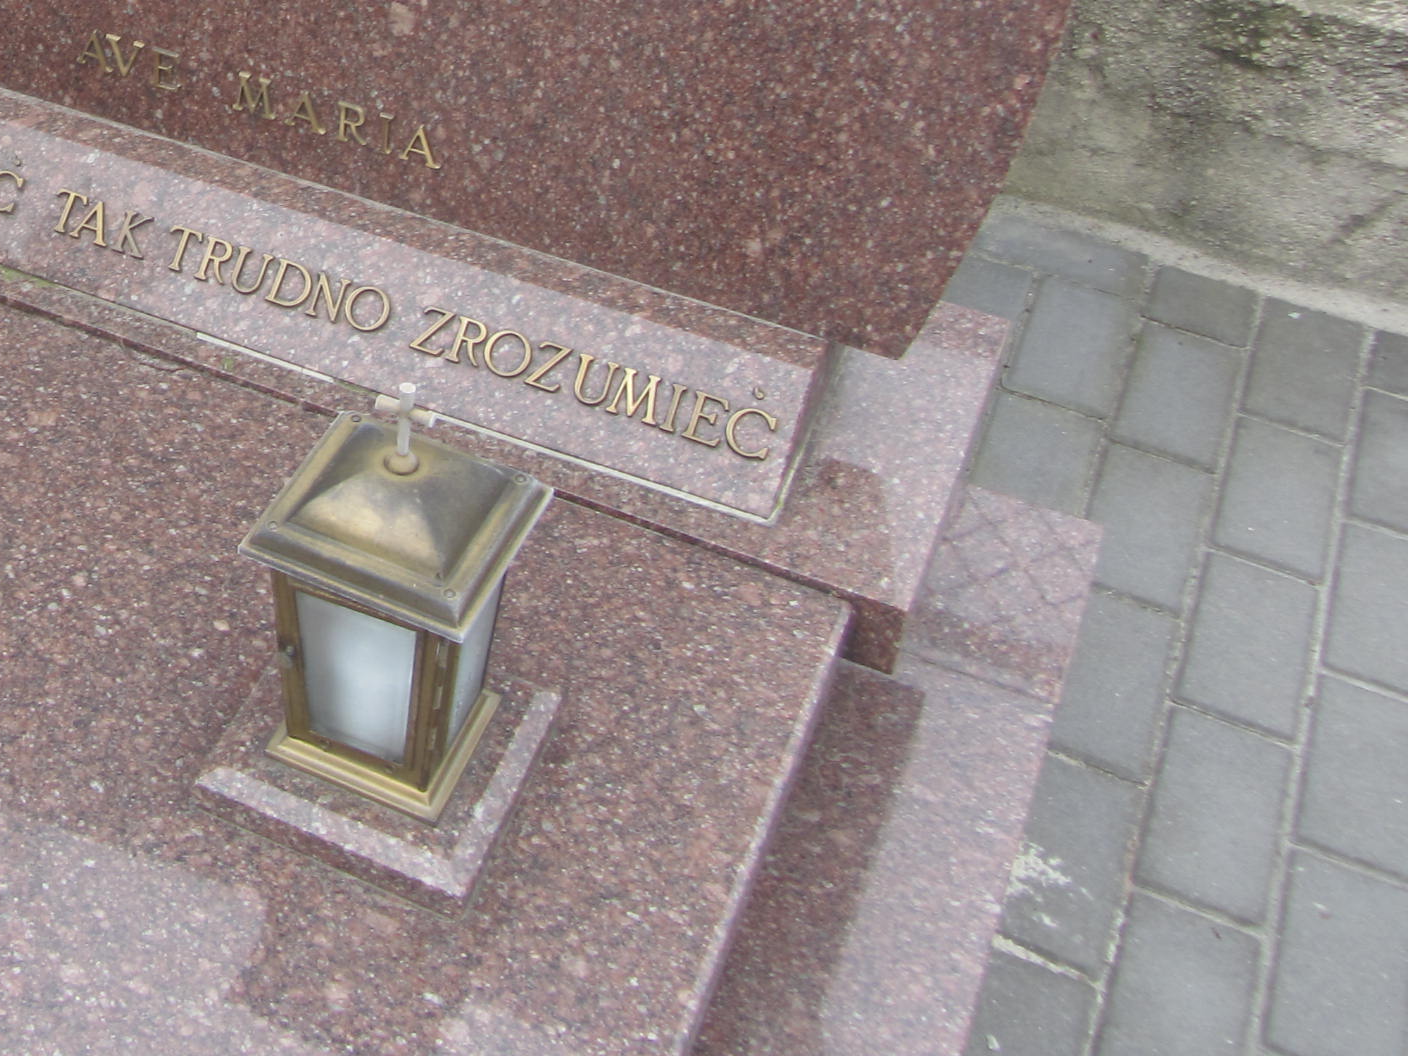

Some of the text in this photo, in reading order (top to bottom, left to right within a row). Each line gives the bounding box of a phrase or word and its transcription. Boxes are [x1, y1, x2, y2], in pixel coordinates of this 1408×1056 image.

[76, 30, 442, 171] AVE MARIA
[53, 187, 156, 260] TAK
[167, 224, 392, 334] TRUDNO
